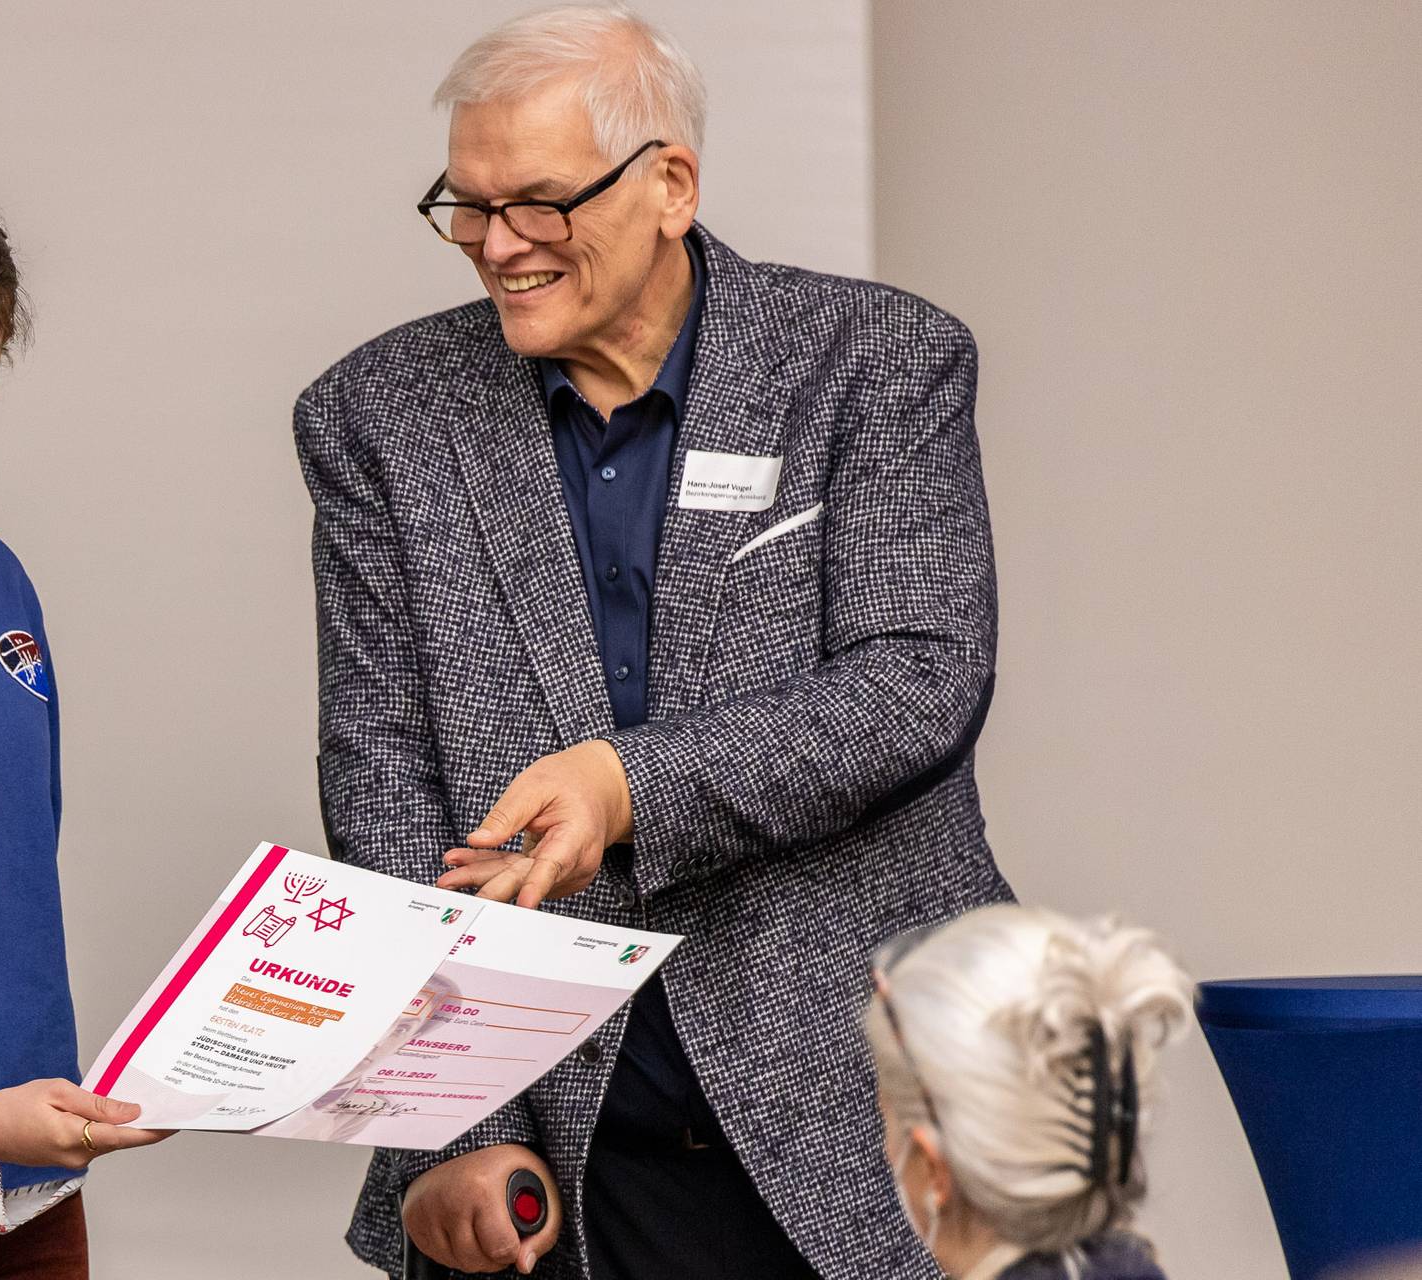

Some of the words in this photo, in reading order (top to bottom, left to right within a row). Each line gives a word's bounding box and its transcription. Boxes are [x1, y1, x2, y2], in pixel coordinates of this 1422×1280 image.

[687, 480, 706, 488] Hans
[731, 484, 752, 493] Vogel
[249, 957, 355, 998] URKUNDE
[231, 984, 259, 999] Neues
[260, 992, 307, 1012] Gymnasium
[308, 1005, 341, 1021] Bochum
[440, 1003, 480, 1016] 150,00
[289, 1013, 306, 1022] der
[209, 1015, 240, 1029] ERSTEN
[238, 1023, 266, 1037] PLATZ
[196, 1035, 237, 1052] JÜDISCHES
[237, 1046, 259, 1058] LEBEN
[268, 1055, 297, 1065] MEINER
[406, 1038, 472, 1052] ARNSBERG
[190, 1041, 215, 1052] STADT
[219, 1050, 249, 1062] DAMALS
[249, 1057, 265, 1066] UND
[264, 1061, 288, 1070] HEUTE
[377, 1068, 438, 1080] 08.11.2021
[354, 1088, 440, 1098] BEZIRKSREGIERUNG
[440, 1093, 488, 1101] ARNSBERG
